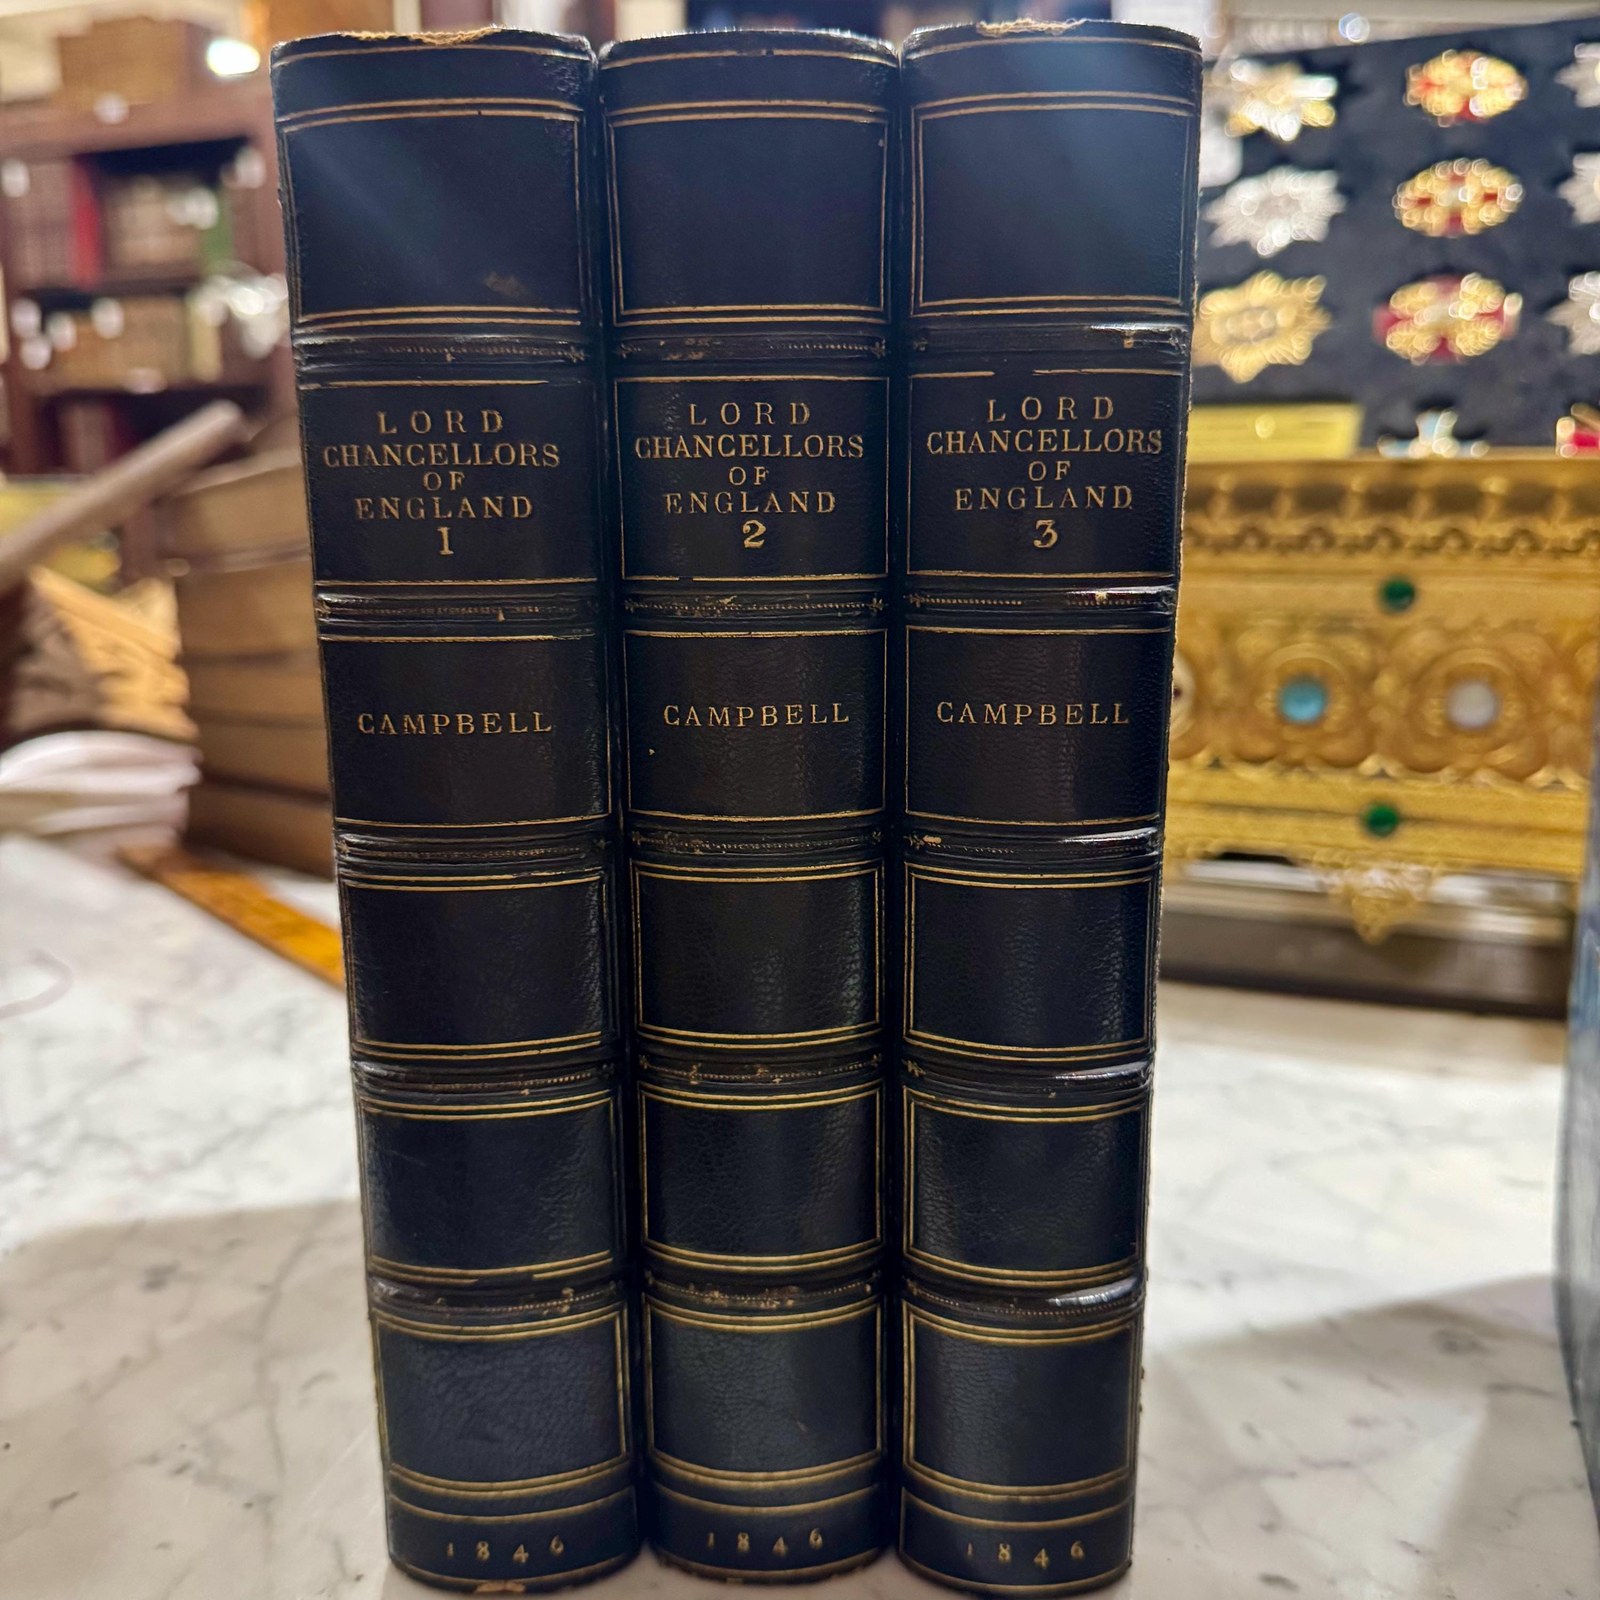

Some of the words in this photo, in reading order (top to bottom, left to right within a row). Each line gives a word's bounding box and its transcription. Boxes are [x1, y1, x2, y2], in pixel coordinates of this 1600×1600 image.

[377, 409, 504, 434] LORD
[689, 402, 811, 426] LORD
[987, 396, 1115, 423] LORD
[635, 434, 865, 459] CHANCELLORS
[927, 428, 1163, 455] CHANCELLORS
[323, 442, 561, 468] CHANCELLORS
[422, 470, 466, 491] OF
[728, 465, 770, 486] OF
[1028, 460, 1072, 481] OF
[354, 495, 534, 520] ENGLAND
[665, 490, 837, 514] ENGLAND
[955, 485, 1134, 511] ENGLAND
[742, 519, 767, 549] 2
[1033, 519, 1059, 549] 3
[357, 711, 553, 735] CAMPBELL
[663, 702, 850, 728] CAMPBELL
[936, 701, 1130, 726] CAMPBELL
[446, 1535, 565, 1564] 1846
[707, 1528, 824, 1558] 1846
[967, 1540, 1085, 1570] 1846
